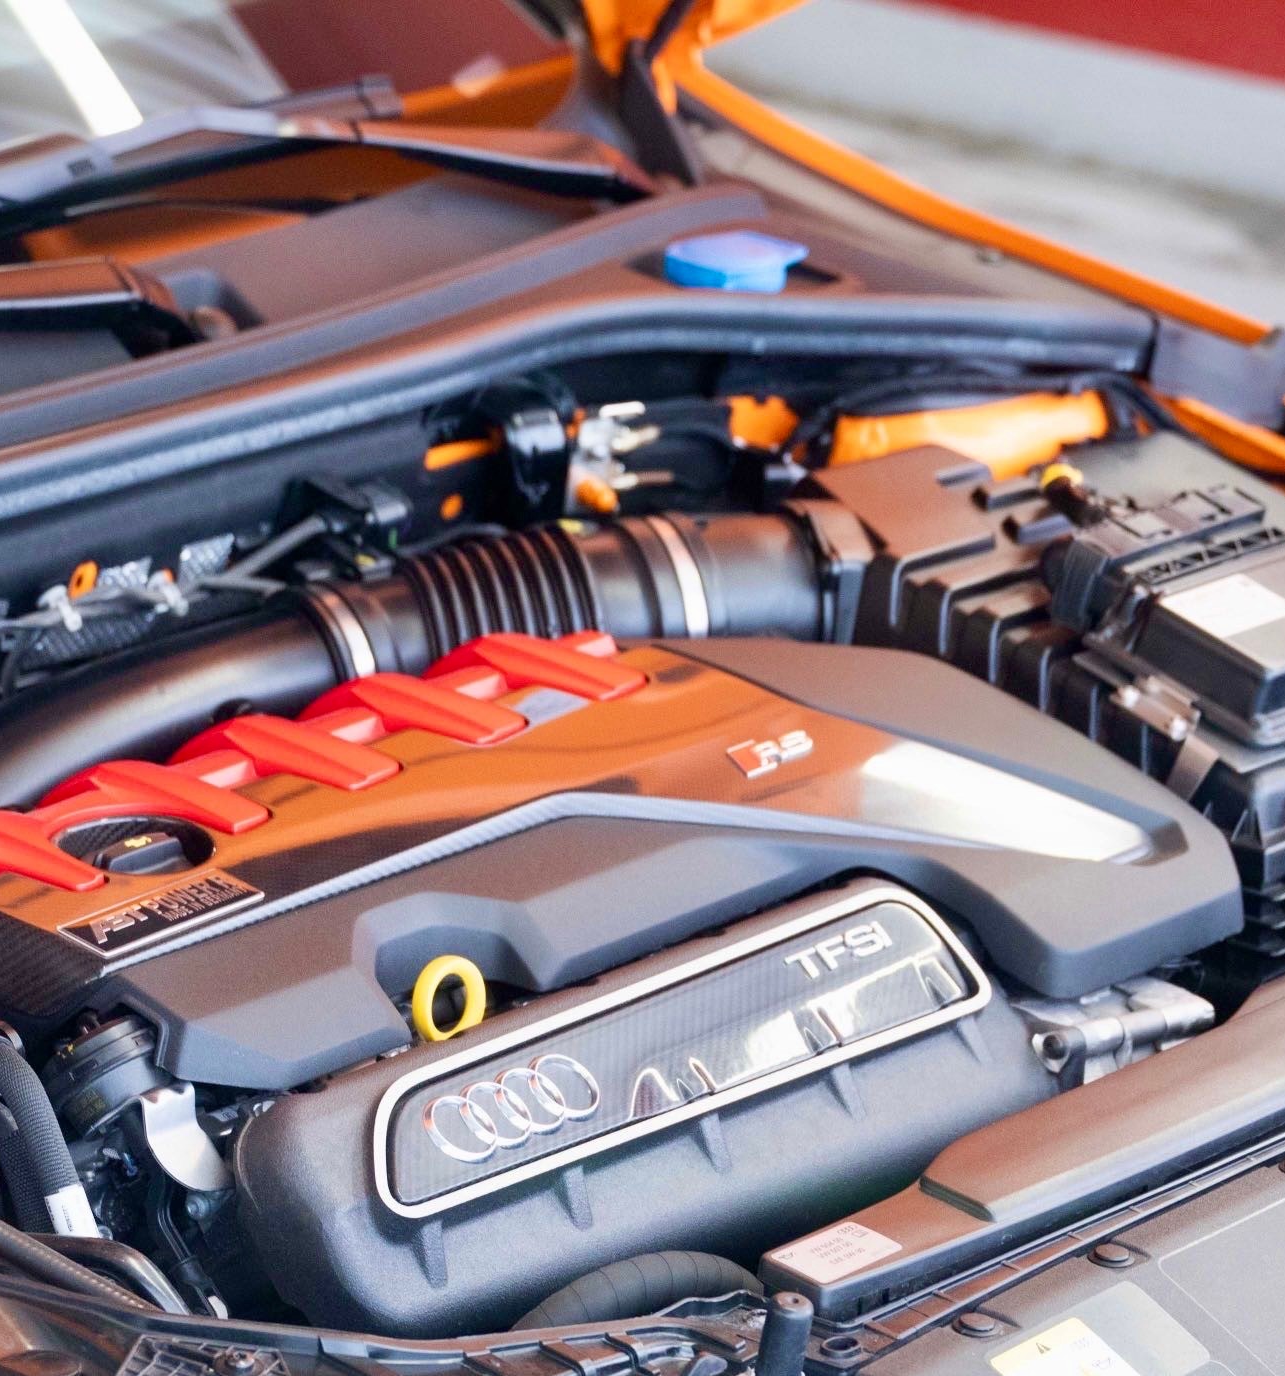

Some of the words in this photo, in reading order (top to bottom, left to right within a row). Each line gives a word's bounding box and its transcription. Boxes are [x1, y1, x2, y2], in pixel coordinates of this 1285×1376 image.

[89, 903, 149, 944] ABT
[140, 880, 214, 915] POWER
[783, 920, 893, 979] TFSI
